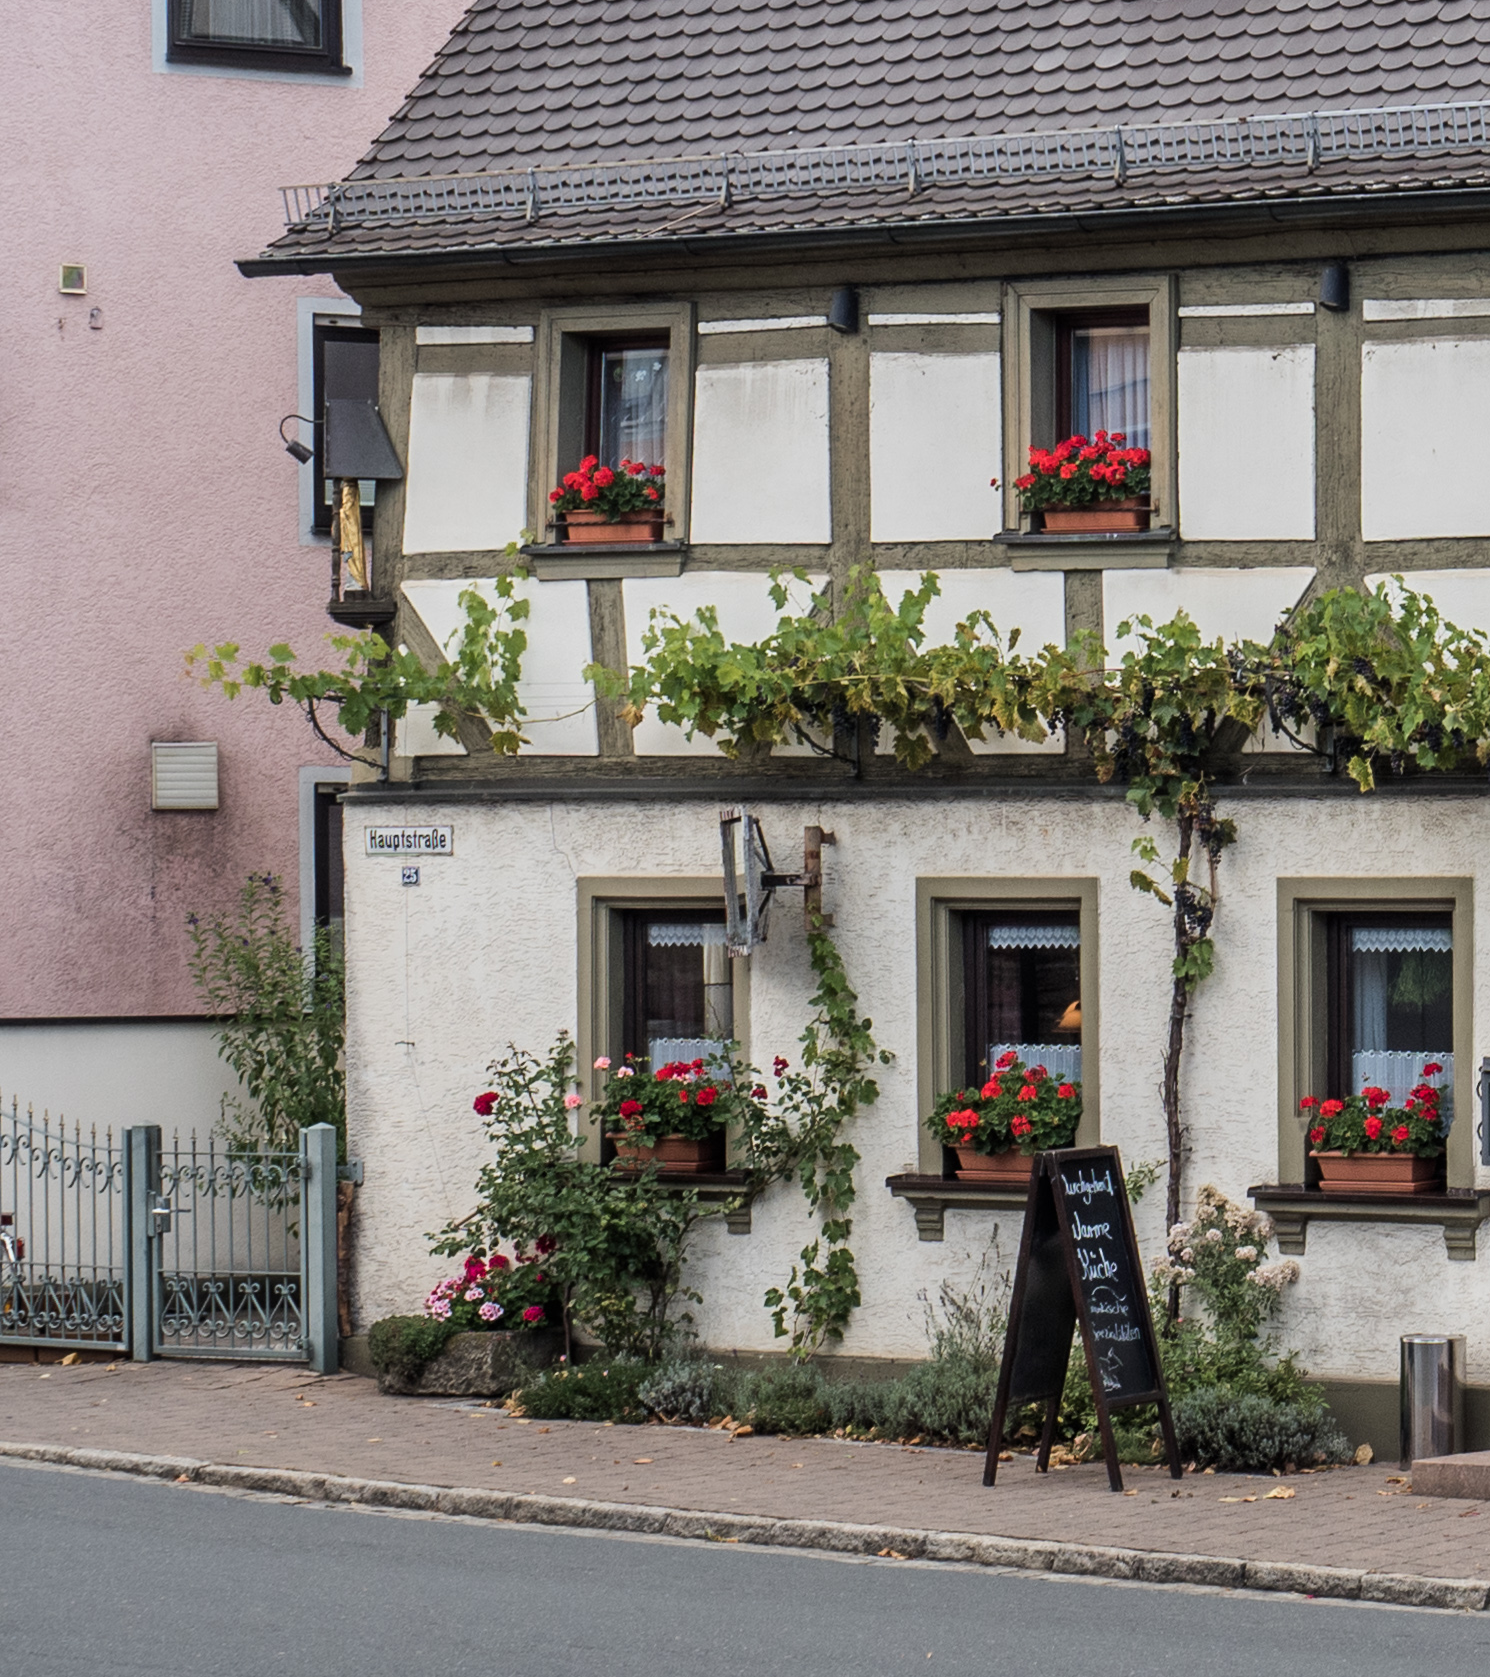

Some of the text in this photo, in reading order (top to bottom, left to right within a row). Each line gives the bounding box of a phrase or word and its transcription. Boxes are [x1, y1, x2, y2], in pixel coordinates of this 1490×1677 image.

[369, 828, 447, 852] Hauptstraße
[403, 868, 418, 883] 25
[1077, 1247, 1119, 1282] Küche
